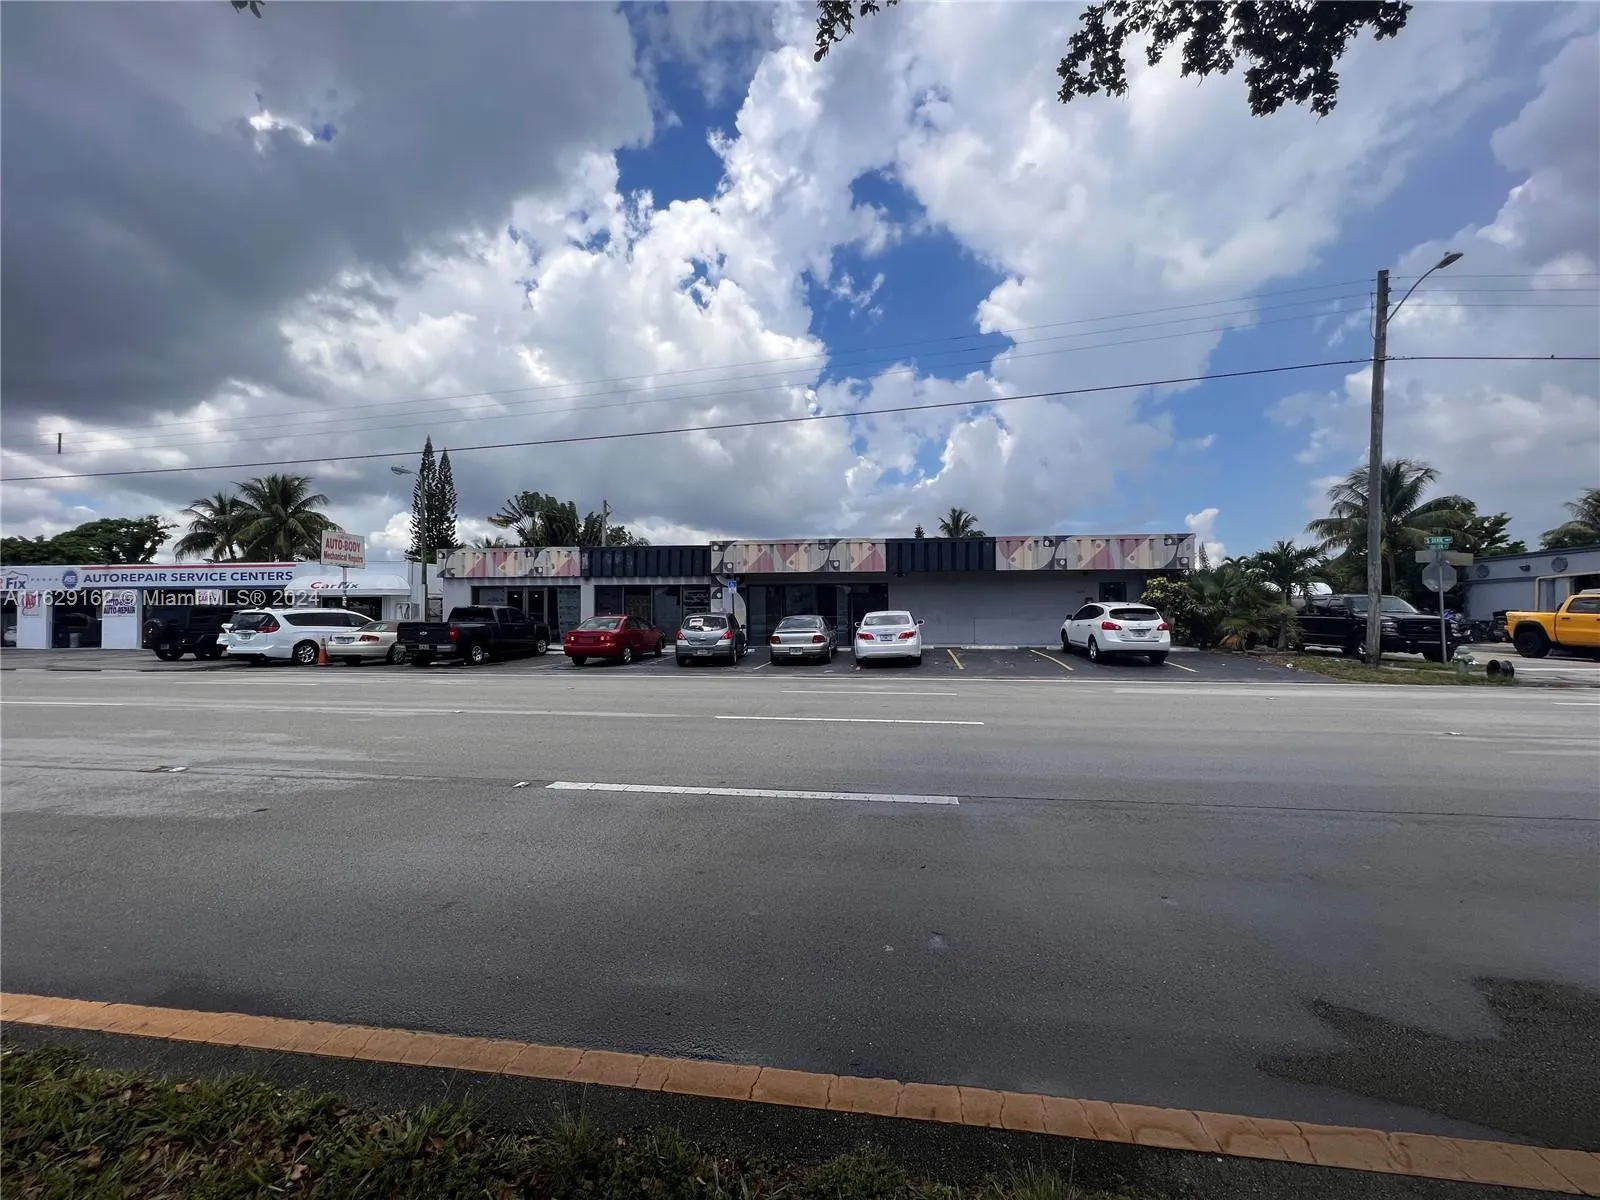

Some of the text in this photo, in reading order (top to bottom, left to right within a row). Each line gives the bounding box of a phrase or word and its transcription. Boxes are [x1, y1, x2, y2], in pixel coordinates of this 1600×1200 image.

[325, 537, 361, 553] AUTO-BODY
[323, 550, 348, 562] Mechanical
[6, 576, 26, 590] Fix
[83, 571, 293, 583] AUTOREPAIR SERVICE CENTERS
